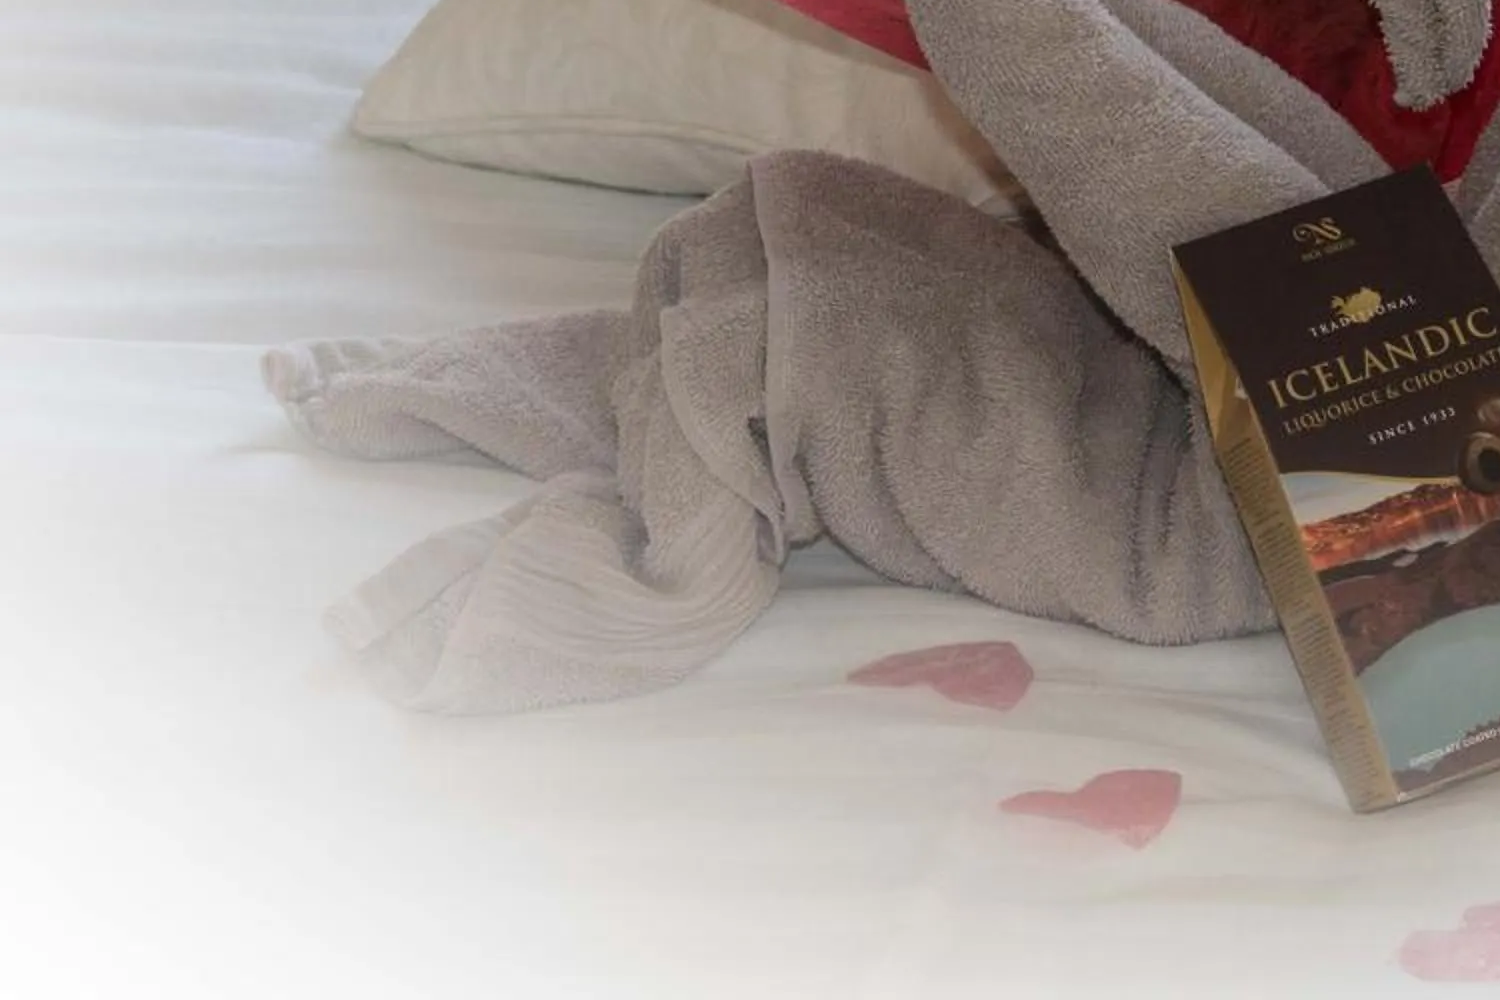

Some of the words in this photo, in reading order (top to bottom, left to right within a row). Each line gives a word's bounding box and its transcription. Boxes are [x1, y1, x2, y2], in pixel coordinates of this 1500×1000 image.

[1308, 295, 1417, 337] TRADITIONAL
[1267, 307, 1497, 409] ICELANDIC
[1283, 390, 1382, 434] LIQUORICE
[1386, 383, 1401, 400] &
[1367, 421, 1416, 445] SINCE
[1421, 407, 1457, 427] 1933
